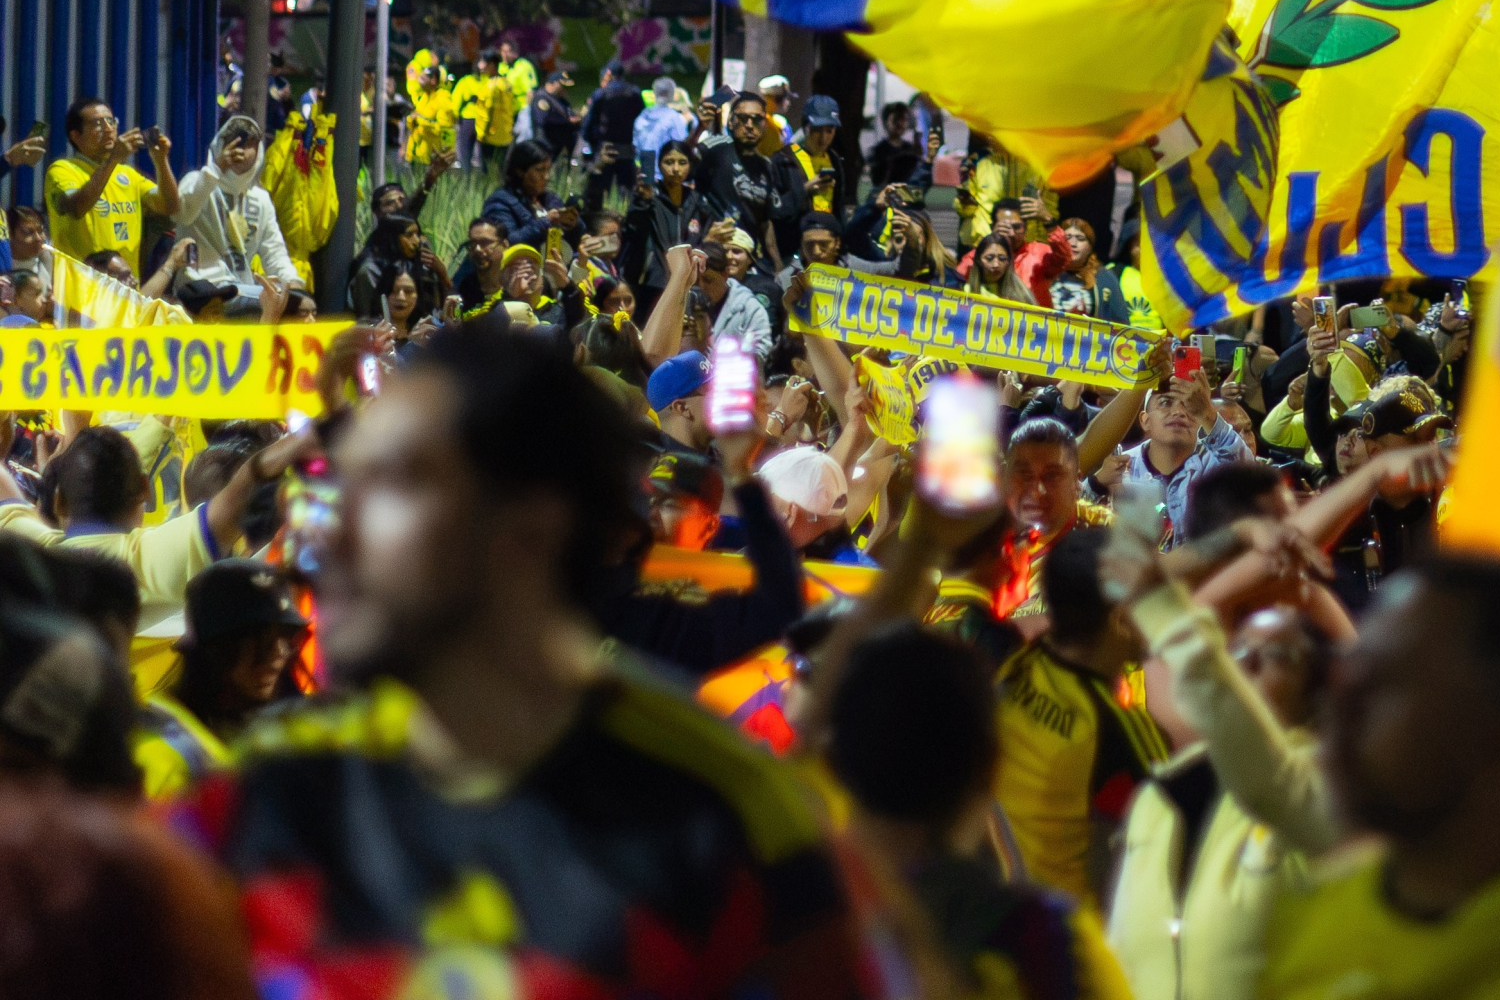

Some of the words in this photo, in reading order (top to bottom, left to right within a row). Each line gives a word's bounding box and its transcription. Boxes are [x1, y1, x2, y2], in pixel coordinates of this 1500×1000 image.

[838, 281, 901, 337] LOS
[911, 294, 960, 346] DE
[965, 303, 1112, 373] ORIENTE
